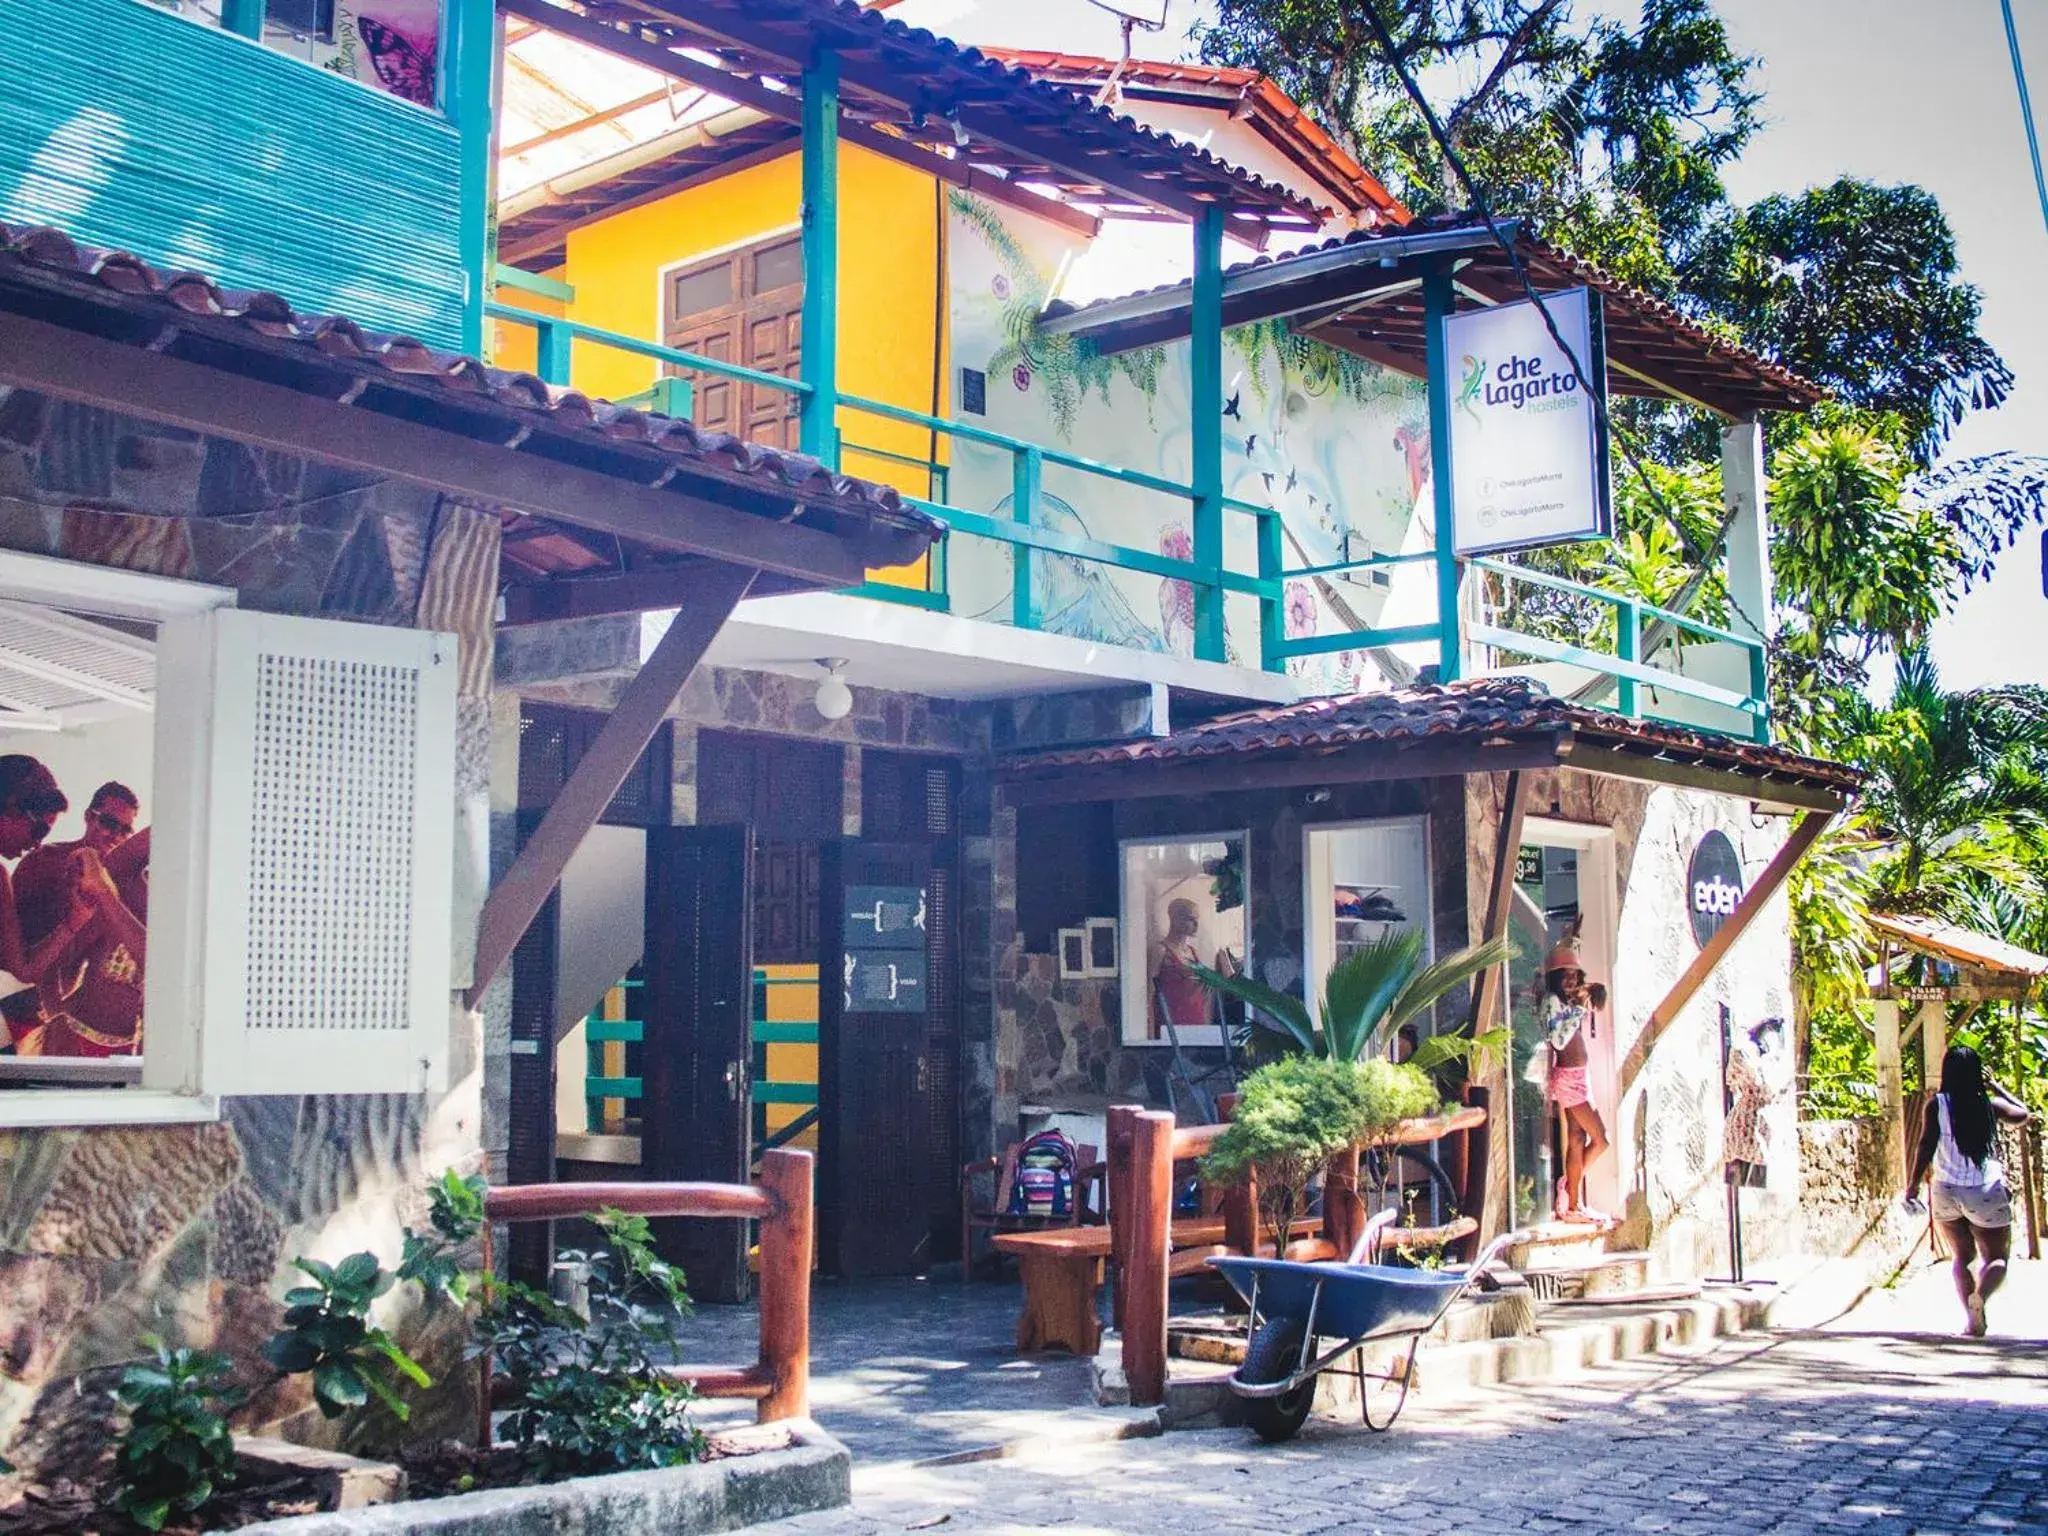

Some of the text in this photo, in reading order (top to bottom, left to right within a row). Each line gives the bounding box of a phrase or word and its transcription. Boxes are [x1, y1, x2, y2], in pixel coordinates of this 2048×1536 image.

[1497, 355, 1542, 382] che
[1527, 395, 1578, 415] hostels
[1694, 875, 1743, 914] eden
